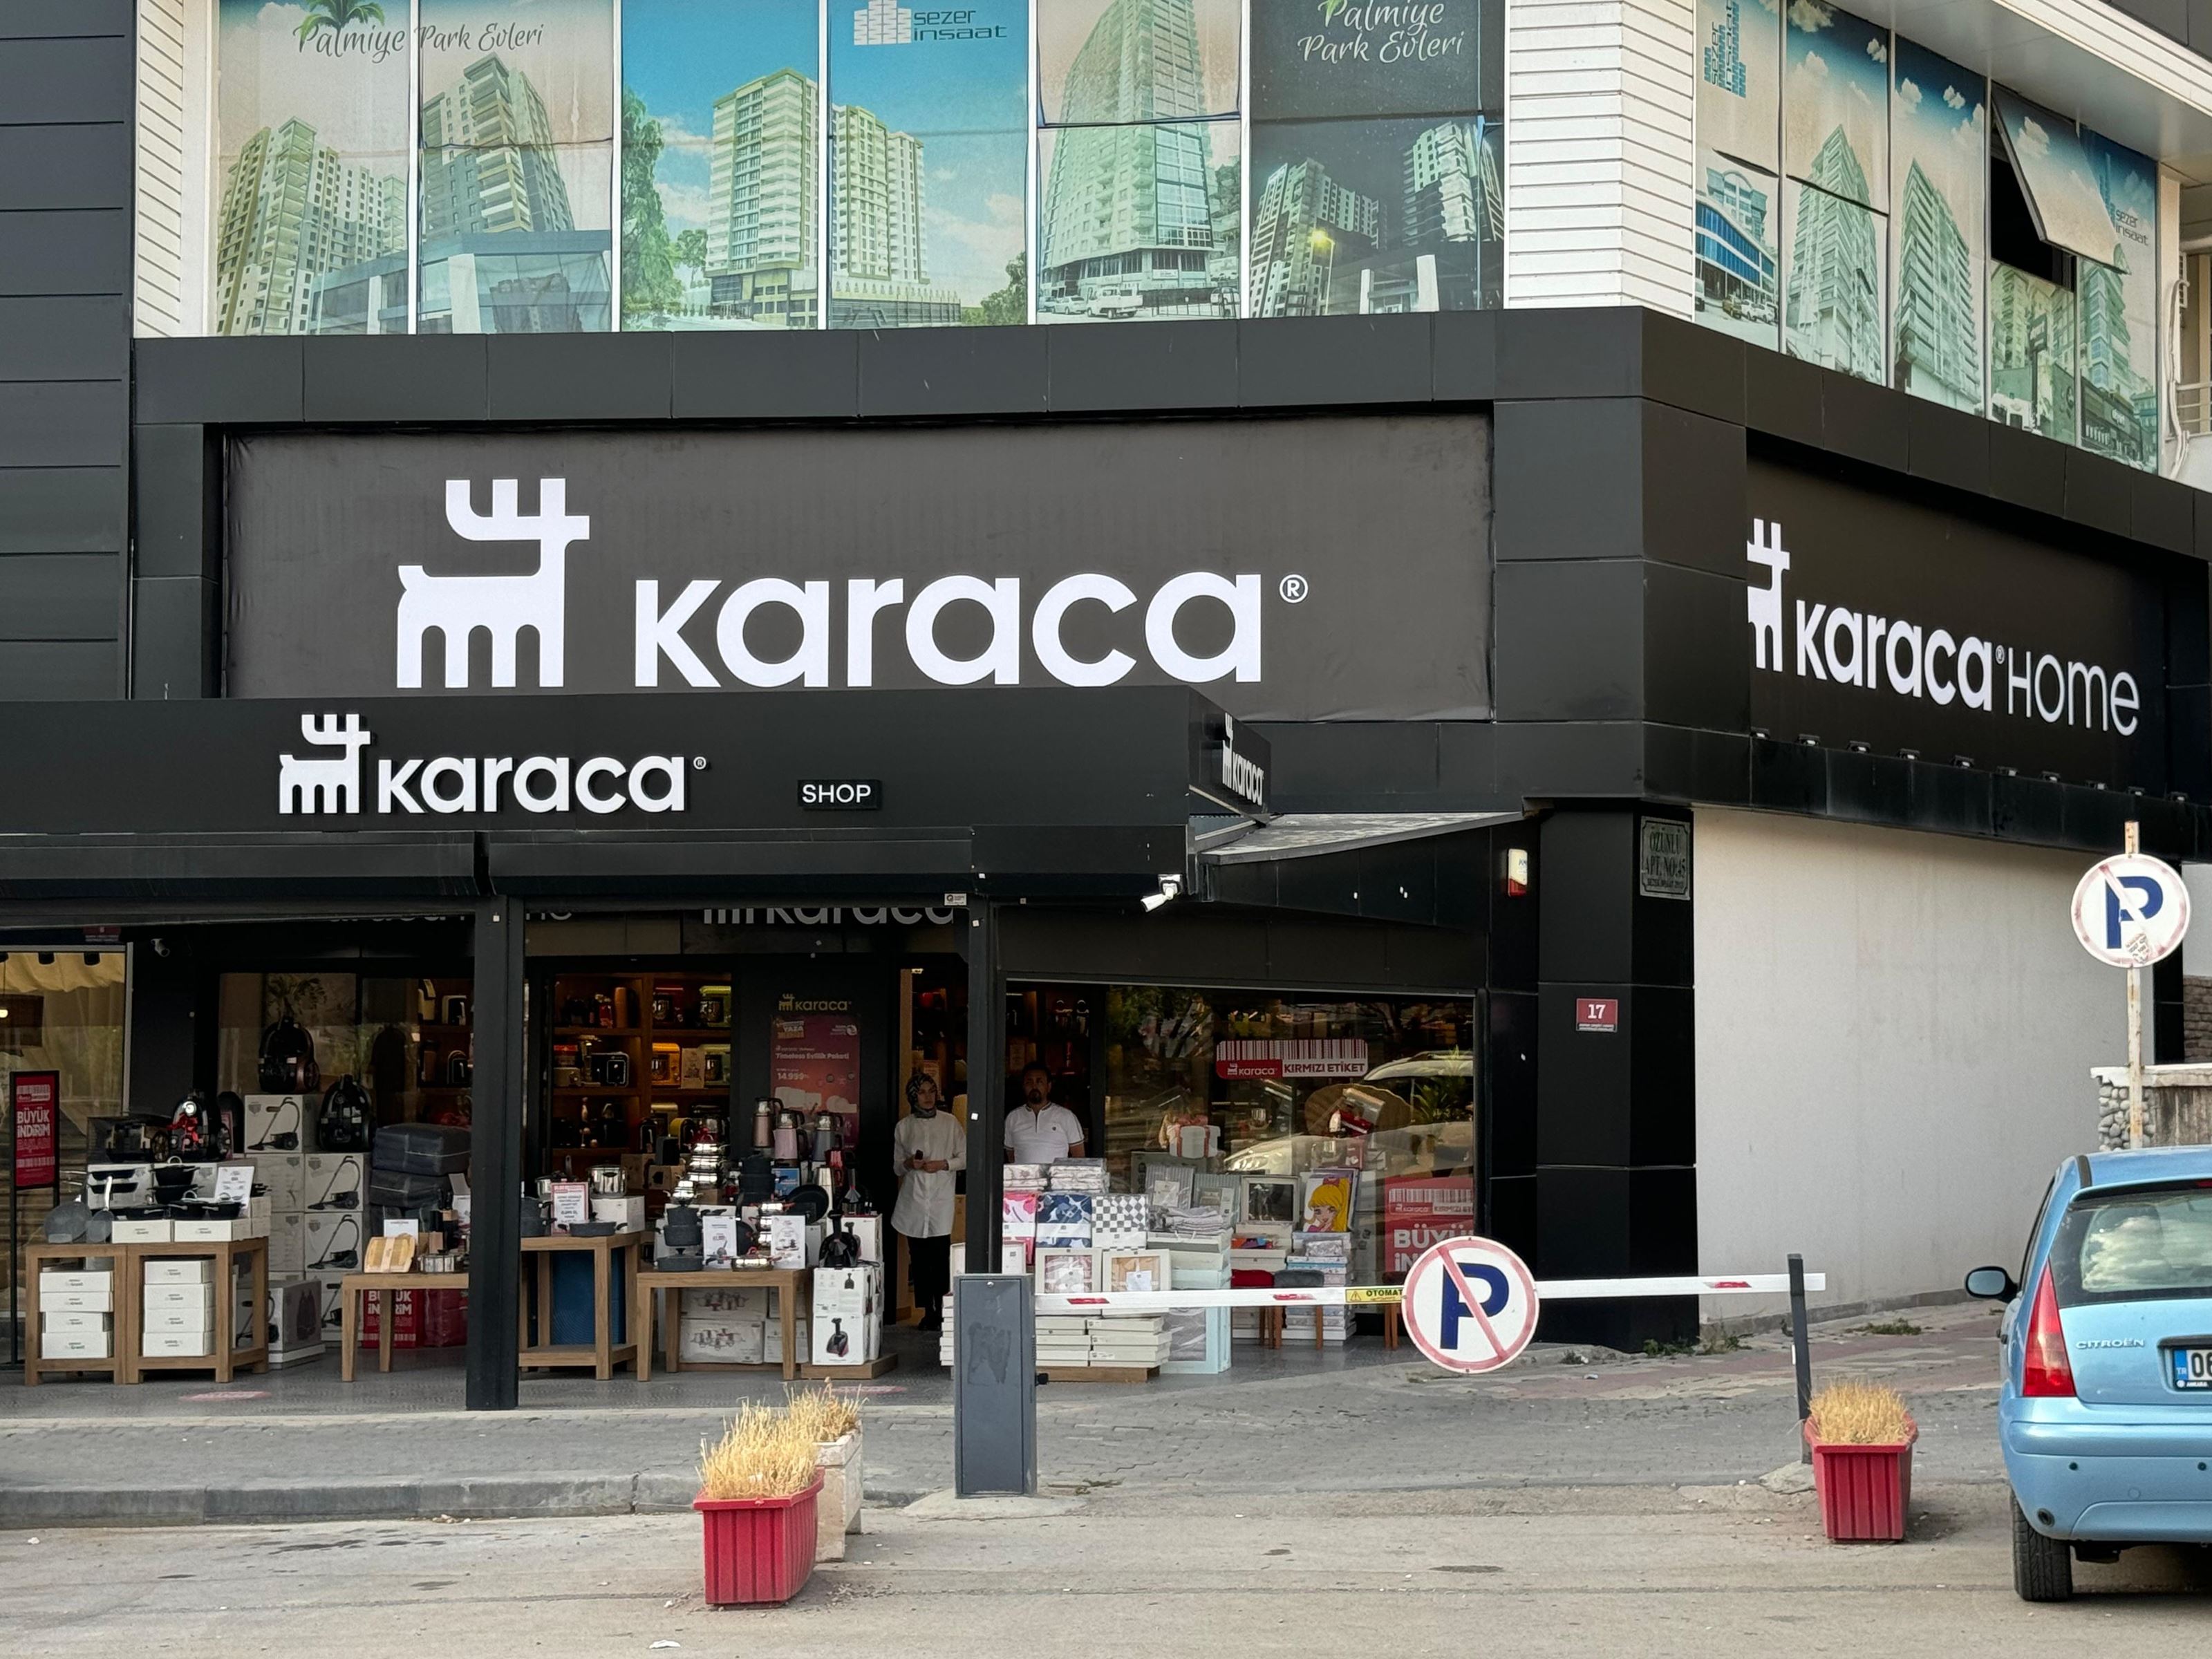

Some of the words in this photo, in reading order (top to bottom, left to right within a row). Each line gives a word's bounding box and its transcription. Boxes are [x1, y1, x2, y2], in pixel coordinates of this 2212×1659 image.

[913, 10, 976, 26] sezer
[1317, 0, 1445, 36] Palmiye
[914, 25, 1008, 41] insaat
[293, 24, 406, 64] Palmiye
[413, 24, 471, 52] Park
[478, 22, 545, 52] Evleri
[1297, 32, 1371, 64] Park
[1379, 29, 1465, 64] Evleri
[801, 783, 872, 804] SHOP
[1587, 1004, 1606, 1020] 17
[1284, 1063, 1325, 1073] KIRMIZI
[1327, 1061, 1365, 1073] ETİKET
[17, 1107, 50, 1124] BÜYÜK
[2075, 1338, 2145, 1349] CITROËN
[2176, 1367, 2186, 1375] TR
